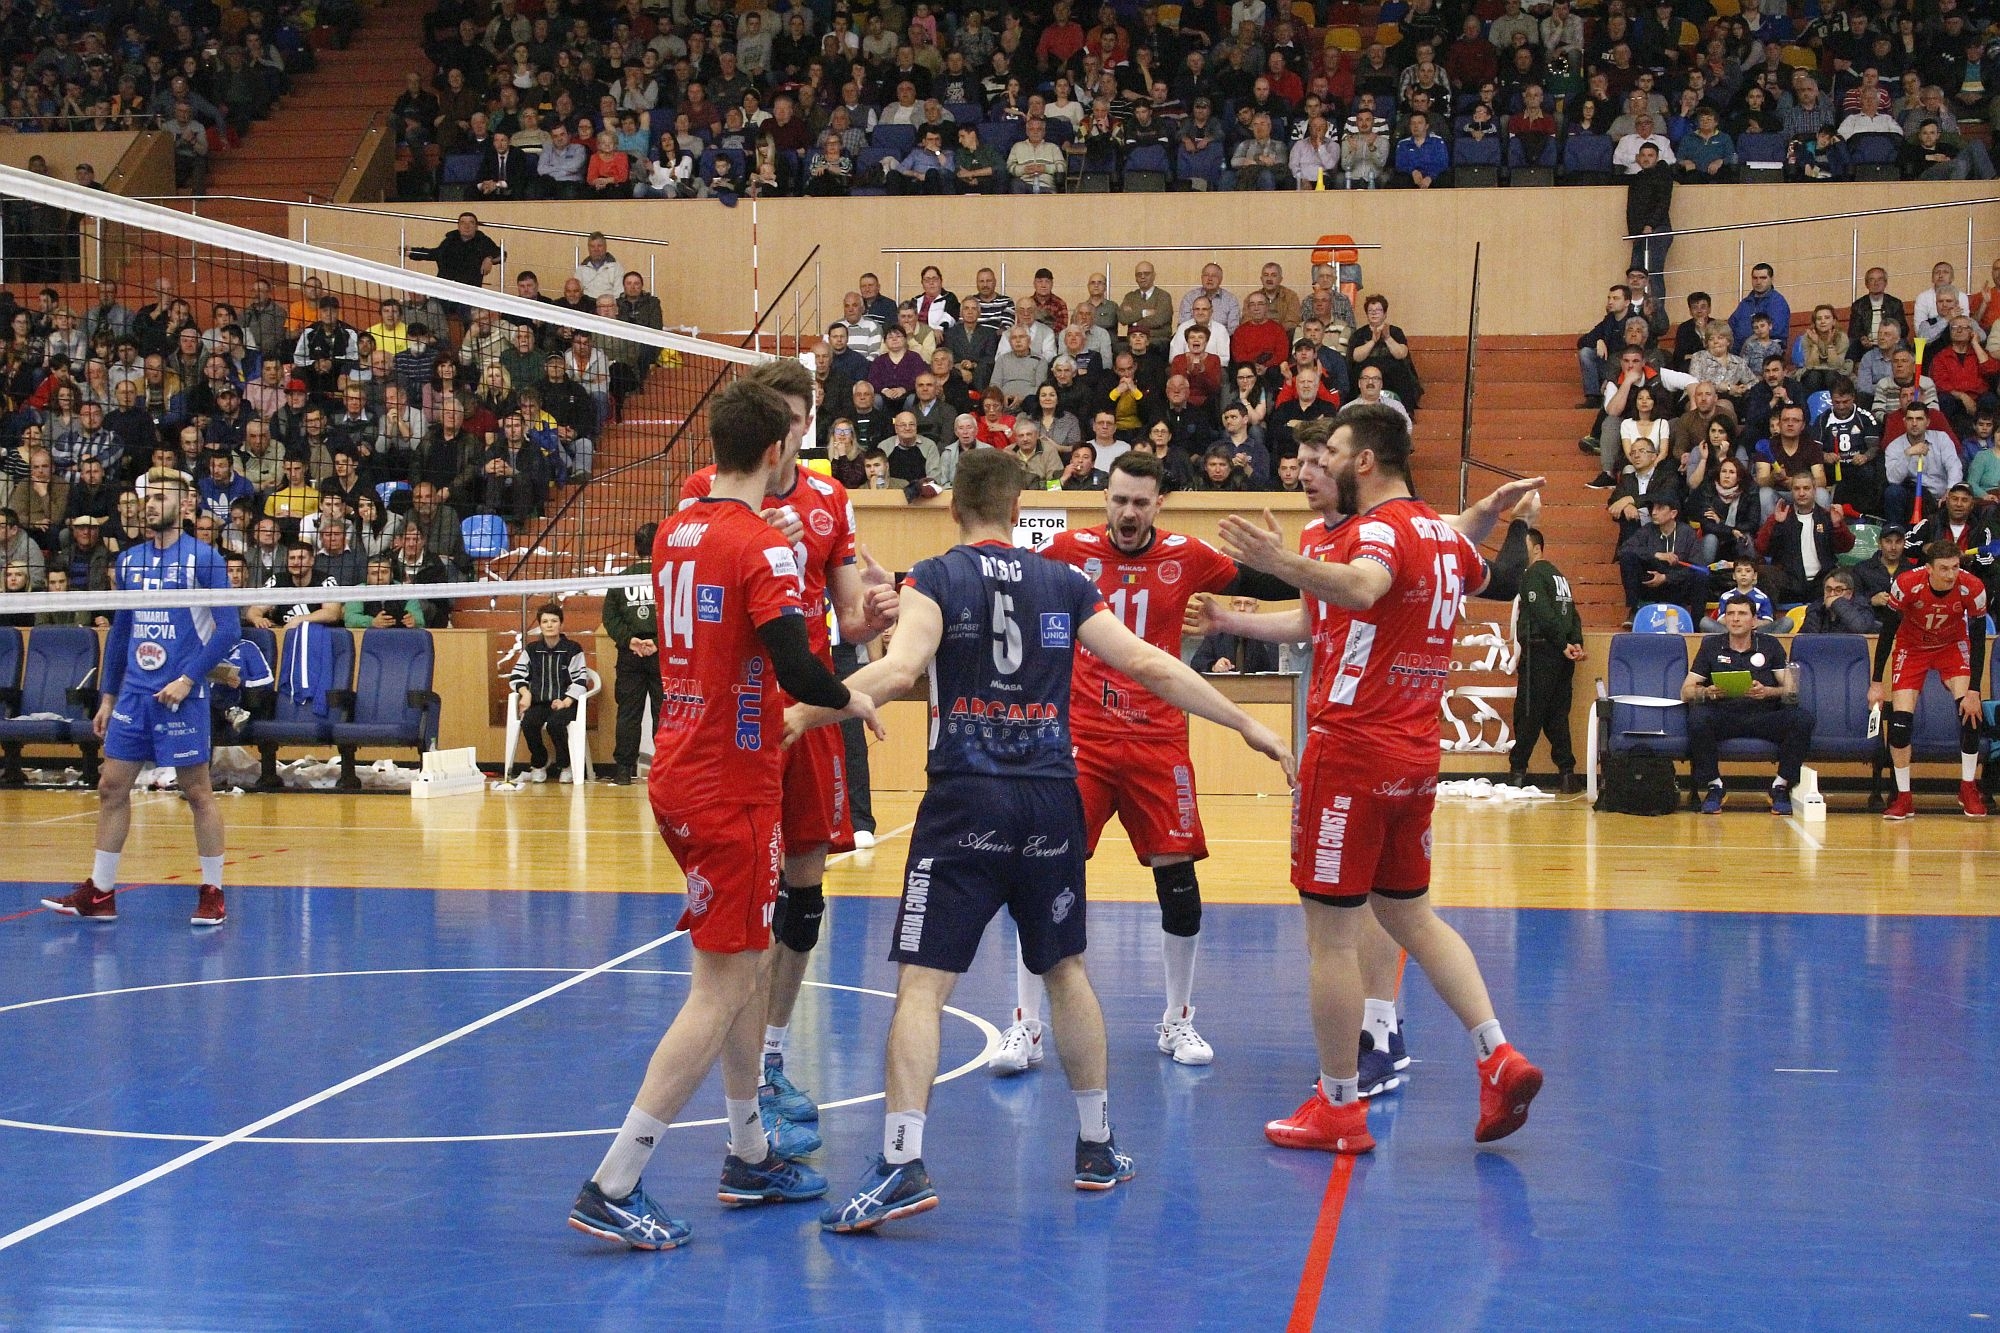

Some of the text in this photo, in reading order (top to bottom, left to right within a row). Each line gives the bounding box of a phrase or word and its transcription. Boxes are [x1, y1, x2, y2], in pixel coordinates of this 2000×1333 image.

[1839, 434, 1851, 451] 8
[1015, 518, 1065, 528] ECTOR
[1032, 532, 1043, 544] B
[624, 585, 656, 600] UN
[658, 561, 695, 648] 14
[1427, 553, 1460, 630] 15
[1110, 589, 1149, 638] 11
[1925, 613, 1949, 630] 17
[993, 591, 1023, 675] 5
[1043, 631, 1068, 639] UNIQA
[731, 655, 763, 751] amiro
[948, 697, 1058, 726] ARCADA
[947, 722, 1060, 740] COMPANY
[1318, 808, 1348, 849] CONST
[1314, 849, 1342, 884] DARIA
[905, 870, 931, 912] CONST
[900, 912, 924, 952] DARIA
